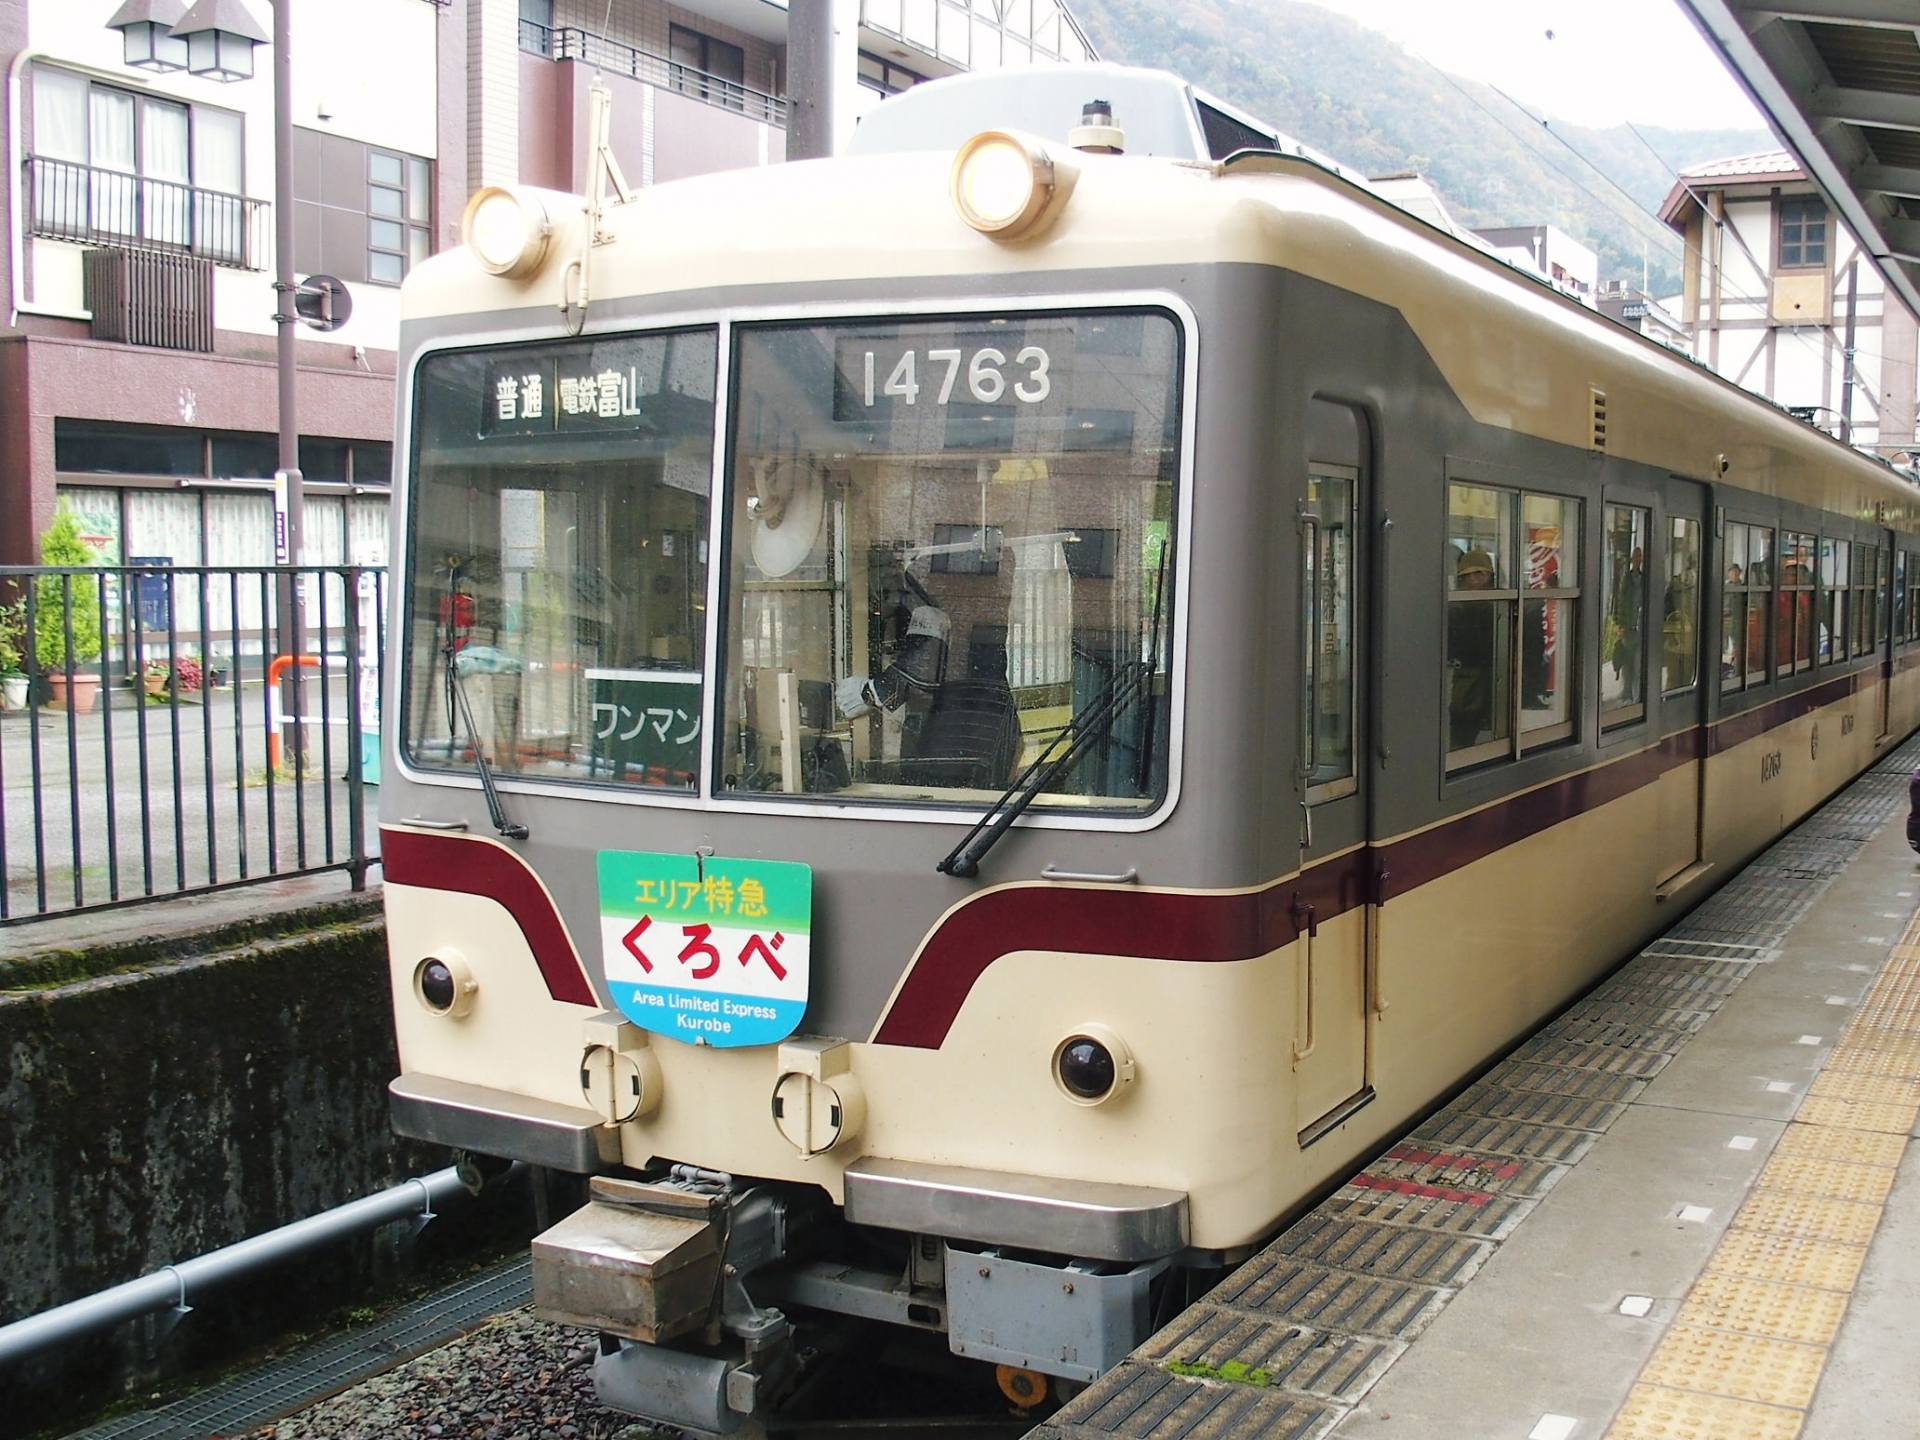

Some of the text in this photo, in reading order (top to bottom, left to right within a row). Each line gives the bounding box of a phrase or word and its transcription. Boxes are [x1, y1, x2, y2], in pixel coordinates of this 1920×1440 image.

[496, 366, 641, 420] 普通 電鉄富山
[865, 346, 1050, 406] 14763
[592, 703, 701, 744] ワンマン
[635, 875, 769, 917] エリア特急
[622, 914, 788, 982] くろべ
[633, 990, 777, 1021] Area Limited Express
[677, 1013, 732, 1034] Kurobe
